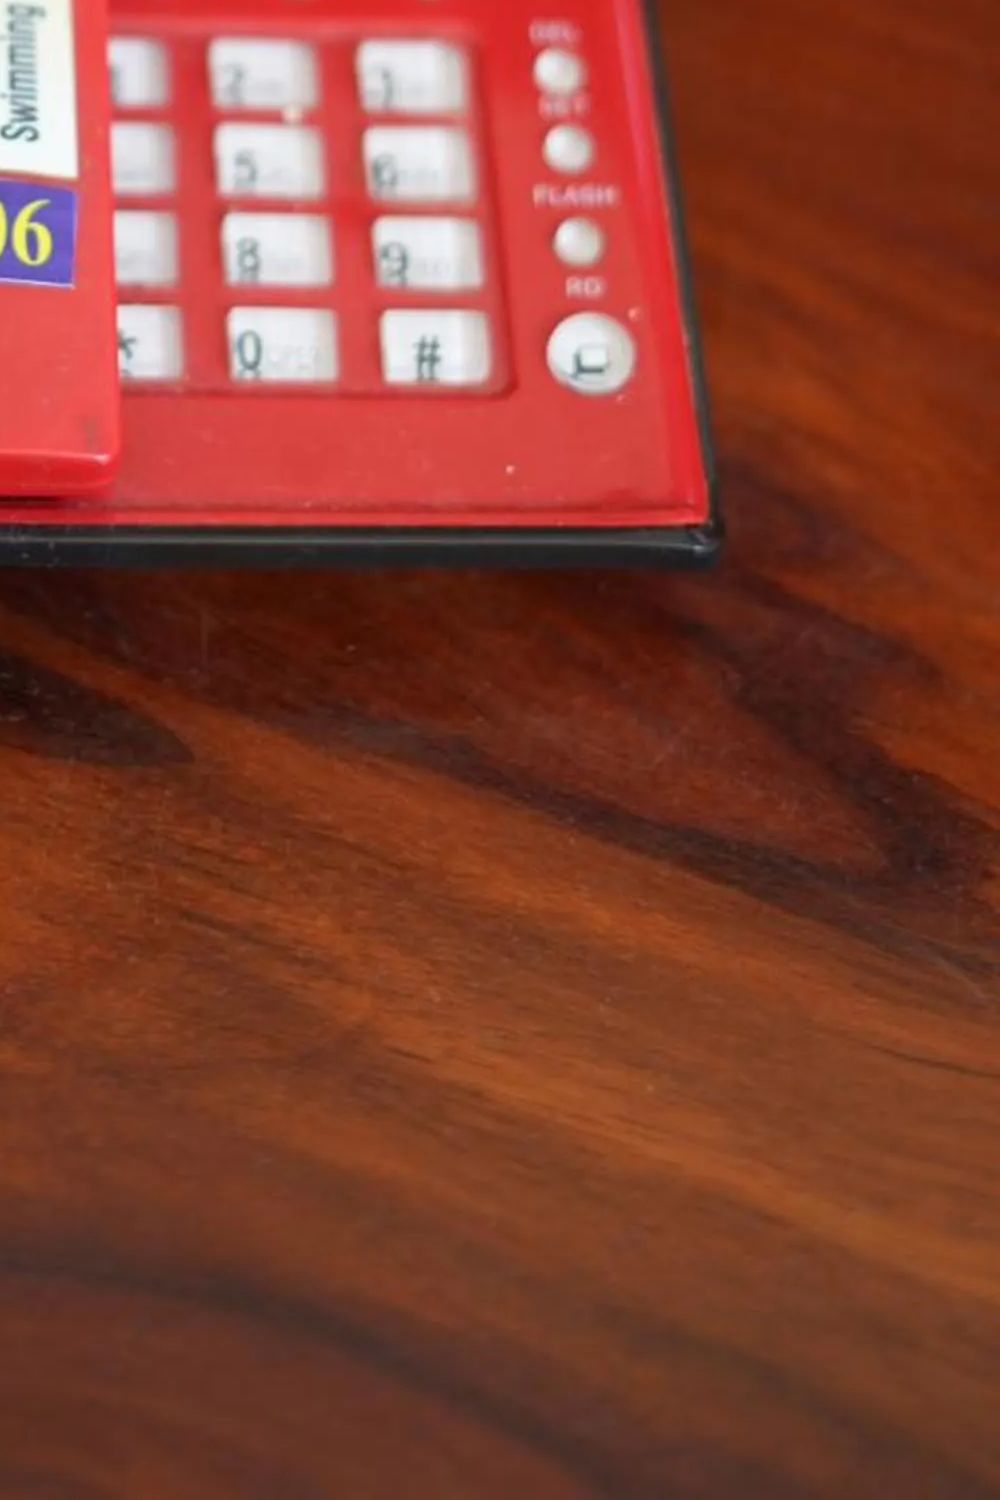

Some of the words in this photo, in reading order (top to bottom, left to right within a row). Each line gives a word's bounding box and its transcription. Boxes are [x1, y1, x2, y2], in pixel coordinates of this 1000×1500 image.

[532, 184, 619, 207] FLASH
[236, 237, 261, 276] 8
[237, 328, 263, 372] 0
